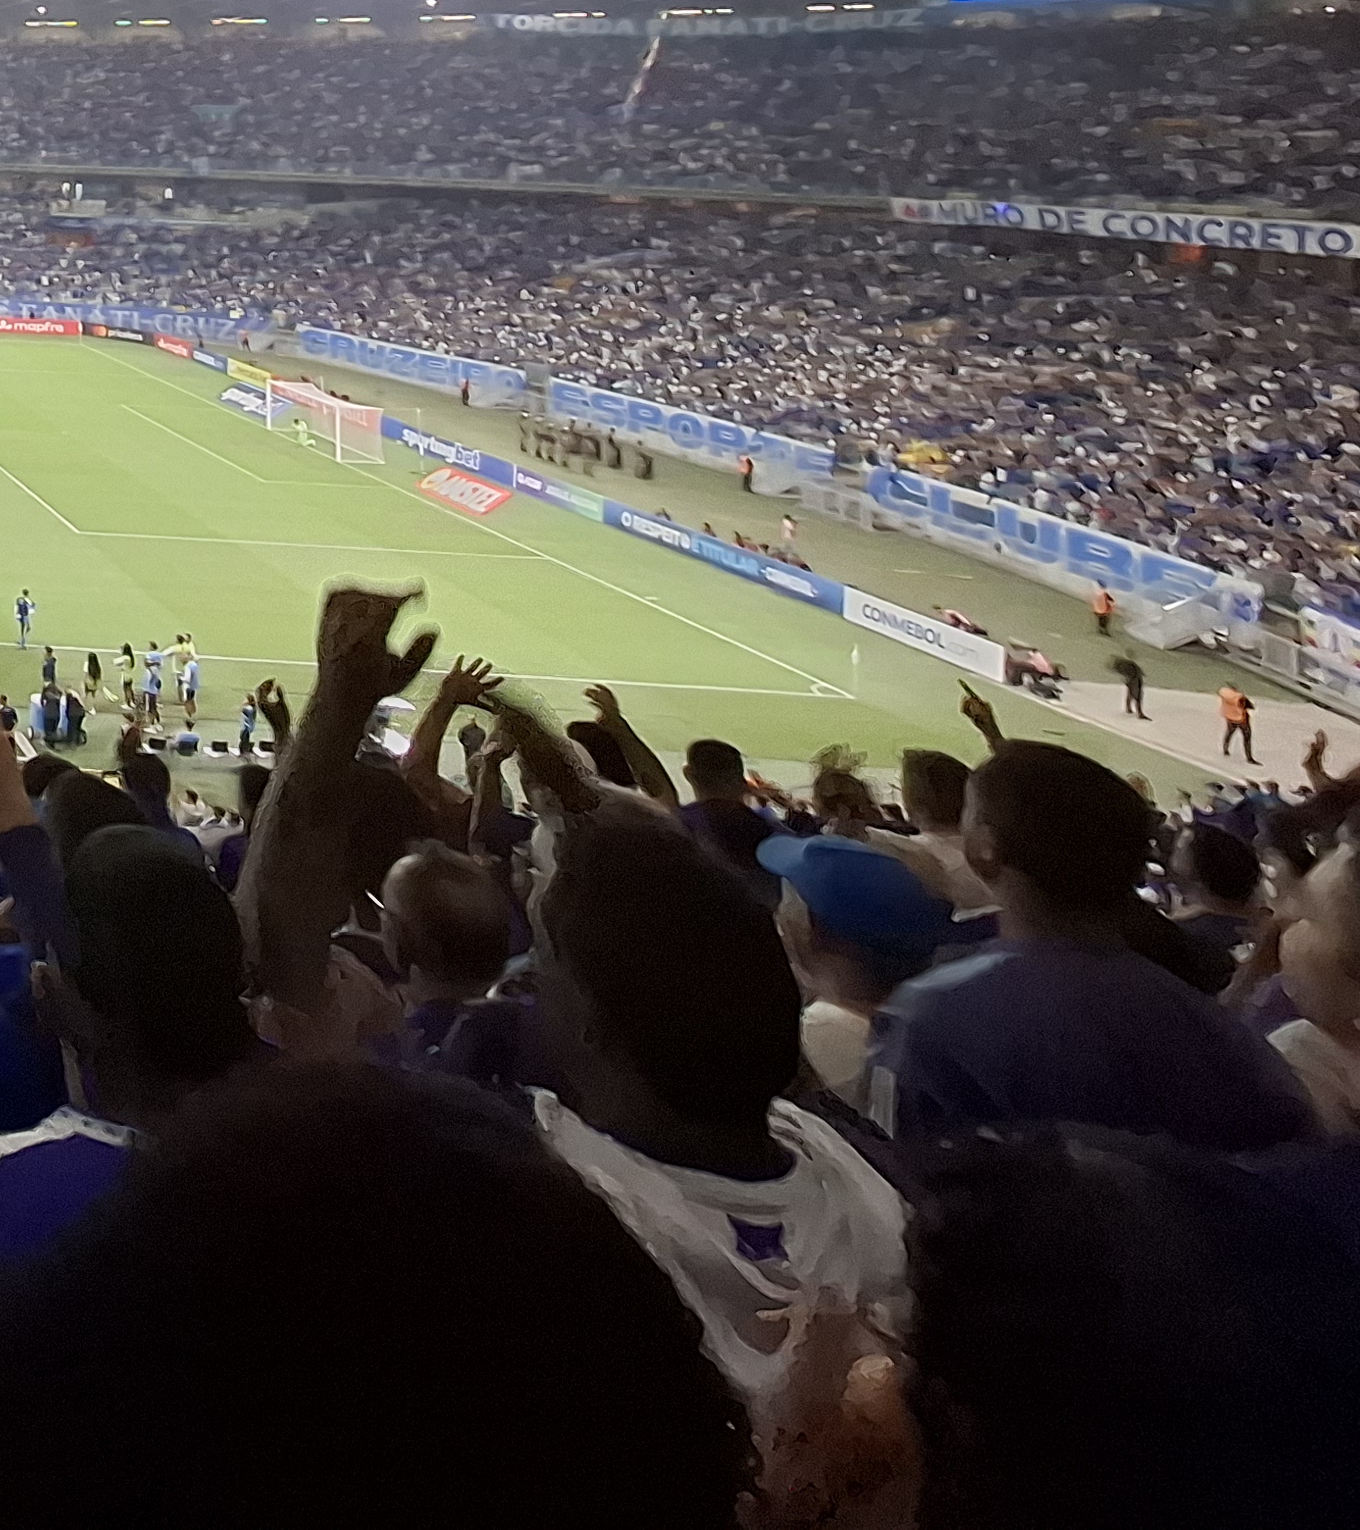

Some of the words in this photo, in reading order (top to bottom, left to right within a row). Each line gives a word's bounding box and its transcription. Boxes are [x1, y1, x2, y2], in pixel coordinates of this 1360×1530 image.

[938, 202, 1024, 228] MURO
[1039, 208, 1084, 233] DE
[1102, 213, 1352, 256] CONCRETO
[14, 321, 65, 334] mapfre
[402, 427, 481, 471] sportingbet
